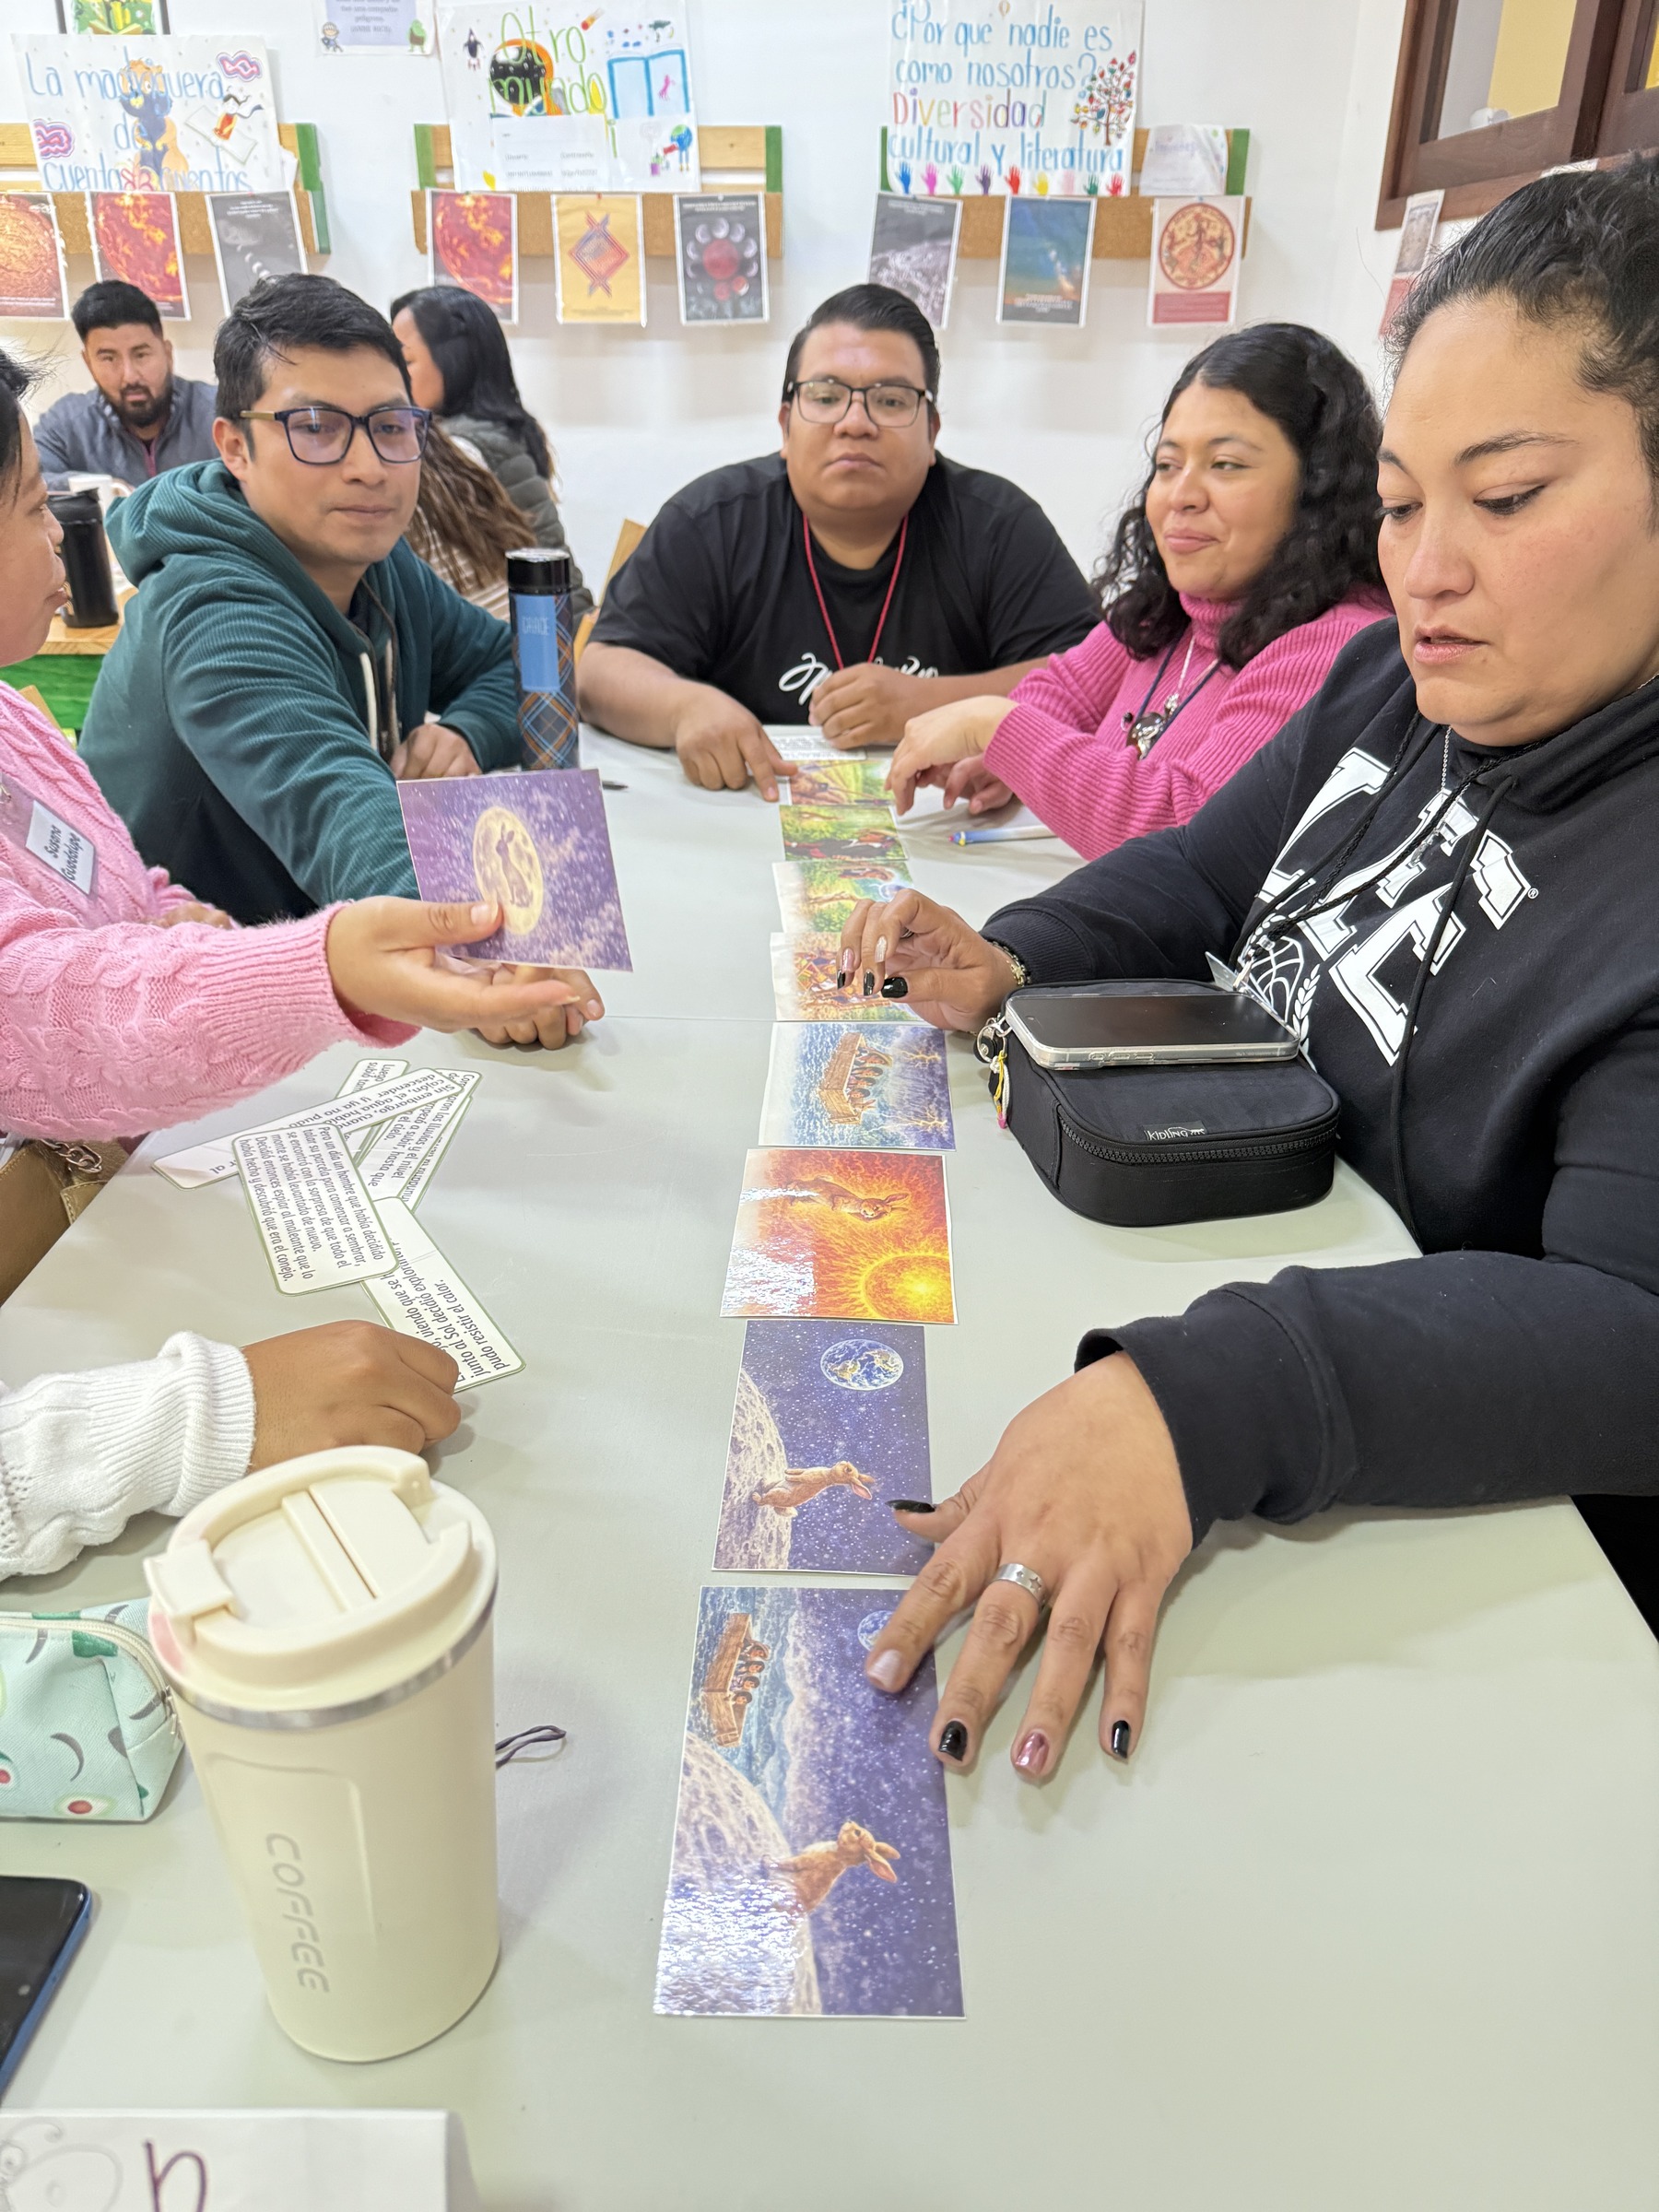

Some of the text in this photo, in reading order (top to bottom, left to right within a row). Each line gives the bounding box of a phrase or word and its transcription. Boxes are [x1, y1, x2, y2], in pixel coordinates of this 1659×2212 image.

[500, 5, 586, 65] Otro
[955, 21, 993, 57] que
[1008, 4, 1070, 48] nadie
[1083, 25, 1113, 52] es
[25, 52, 64, 97] La
[895, 47, 1098, 100] como nosotros?
[488, 64, 608, 117] mundo
[892, 87, 1047, 130] Diversidad
[113, 112, 148, 151] de
[888, 124, 1124, 176] cultural y literatura
[44, 824, 62, 859] Susana
[61, 832, 85, 881] Guadalupe
[378, 1074, 435, 1098] descender
[407, 1079, 444, 1093] cajón,
[434, 1084, 455, 1093] Sin
[324, 1108, 342, 1116] no
[342, 1100, 360, 1109] ya
[360, 1098, 393, 1112] agua
[373, 1092, 432, 1113] embargo,
[289, 1113, 323, 1128] pudo
[302, 1129, 317, 1144] talar
[383, 1124, 405, 1140] cielo.
[415, 1123, 441, 1145] lluvias
[239, 1138, 256, 1158] había
[289, 1139, 312, 1167] encontró
[309, 1145, 320, 1153] su
[244, 1157, 262, 1177] hecho
[309, 1153, 332, 1177] parcela
[379, 1151, 404, 1171] hasta
[391, 1160, 412, 1179] nivel
[300, 1167, 313, 1179] con
[305, 1178, 318, 1187] la
[369, 1173, 384, 1187] que
[271, 1134, 322, 1252] monte se había levantado de nuevo.
[318, 1177, 336, 1193] para
[318, 1126, 384, 1260] Pero un día un hombre que había decidido
[253, 1183, 276, 1217] descubrió
[254, 1136, 315, 1279] Decidió entonces espiar al maleante que lo
[308, 1187, 328, 1217] sorpresa
[329, 1194, 350, 1226] comenzar
[261, 1217, 277, 1231] que
[320, 1217, 334, 1227] de
[269, 1231, 282, 1244] era
[321, 1227, 337, 1241] que
[274, 1245, 288, 1253] el
[329, 1241, 346, 1259] todo
[345, 1233, 367, 1266] sembrar,
[276, 1253, 296, 1281] conejo.
[336, 1260, 352, 1268] el
[434, 1279, 457, 1303] calor.
[387, 1279, 434, 1337] viendo que se
[415, 1293, 449, 1323] decidió
[447, 1303, 465, 1313] el
[437, 1324, 460, 1340] Sol
[456, 1315, 488, 1345] resistir
[448, 1339, 467, 1350] al
[461, 1351, 491, 1378] junto
[480, 1346, 511, 1371] pudo
[265, 1832, 330, 1993] COFFEE
